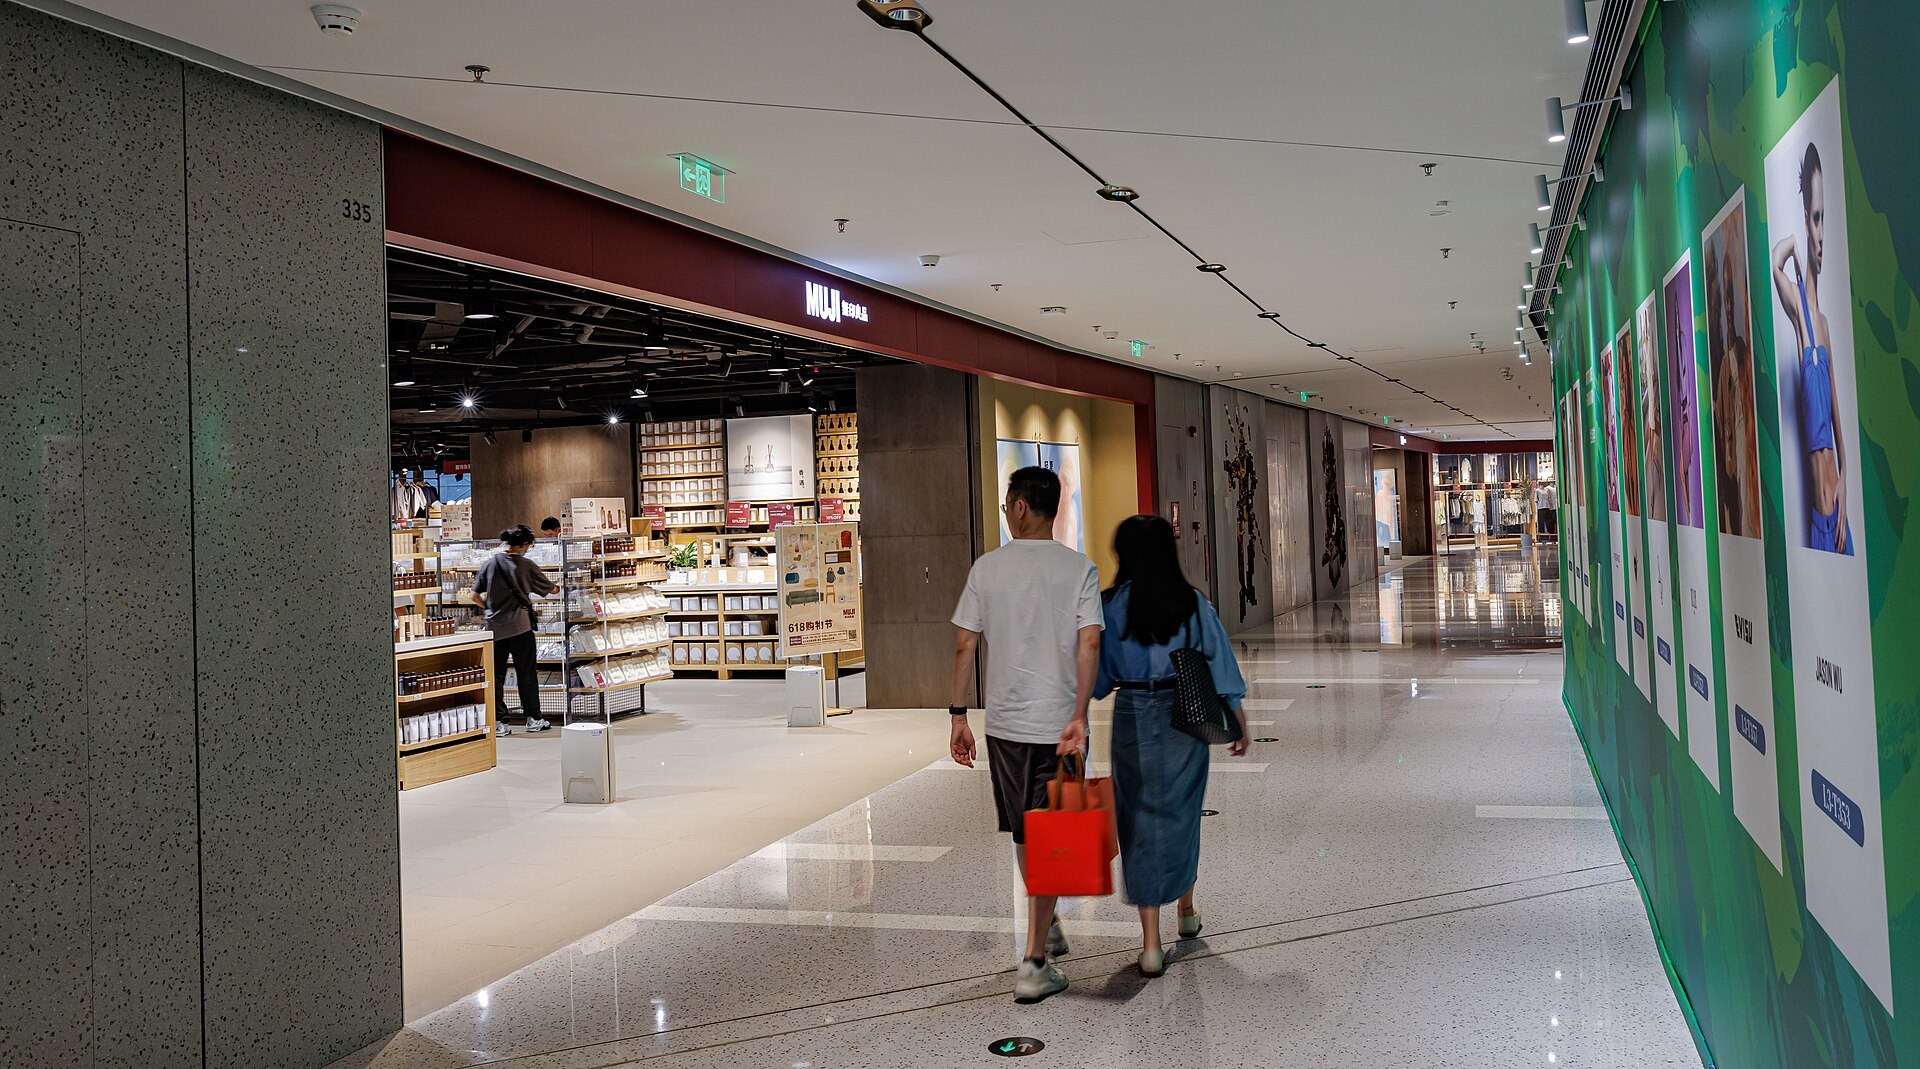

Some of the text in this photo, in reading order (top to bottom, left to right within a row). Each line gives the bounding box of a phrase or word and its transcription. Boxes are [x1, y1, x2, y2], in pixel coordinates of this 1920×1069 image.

[343, 199, 371, 223] 335
[806, 281, 841, 323] MUJI
[788, 619, 832, 632] 618购物节
[1816, 656, 1842, 694] JASON WU
[1822, 783, 1851, 830] L3-T353
